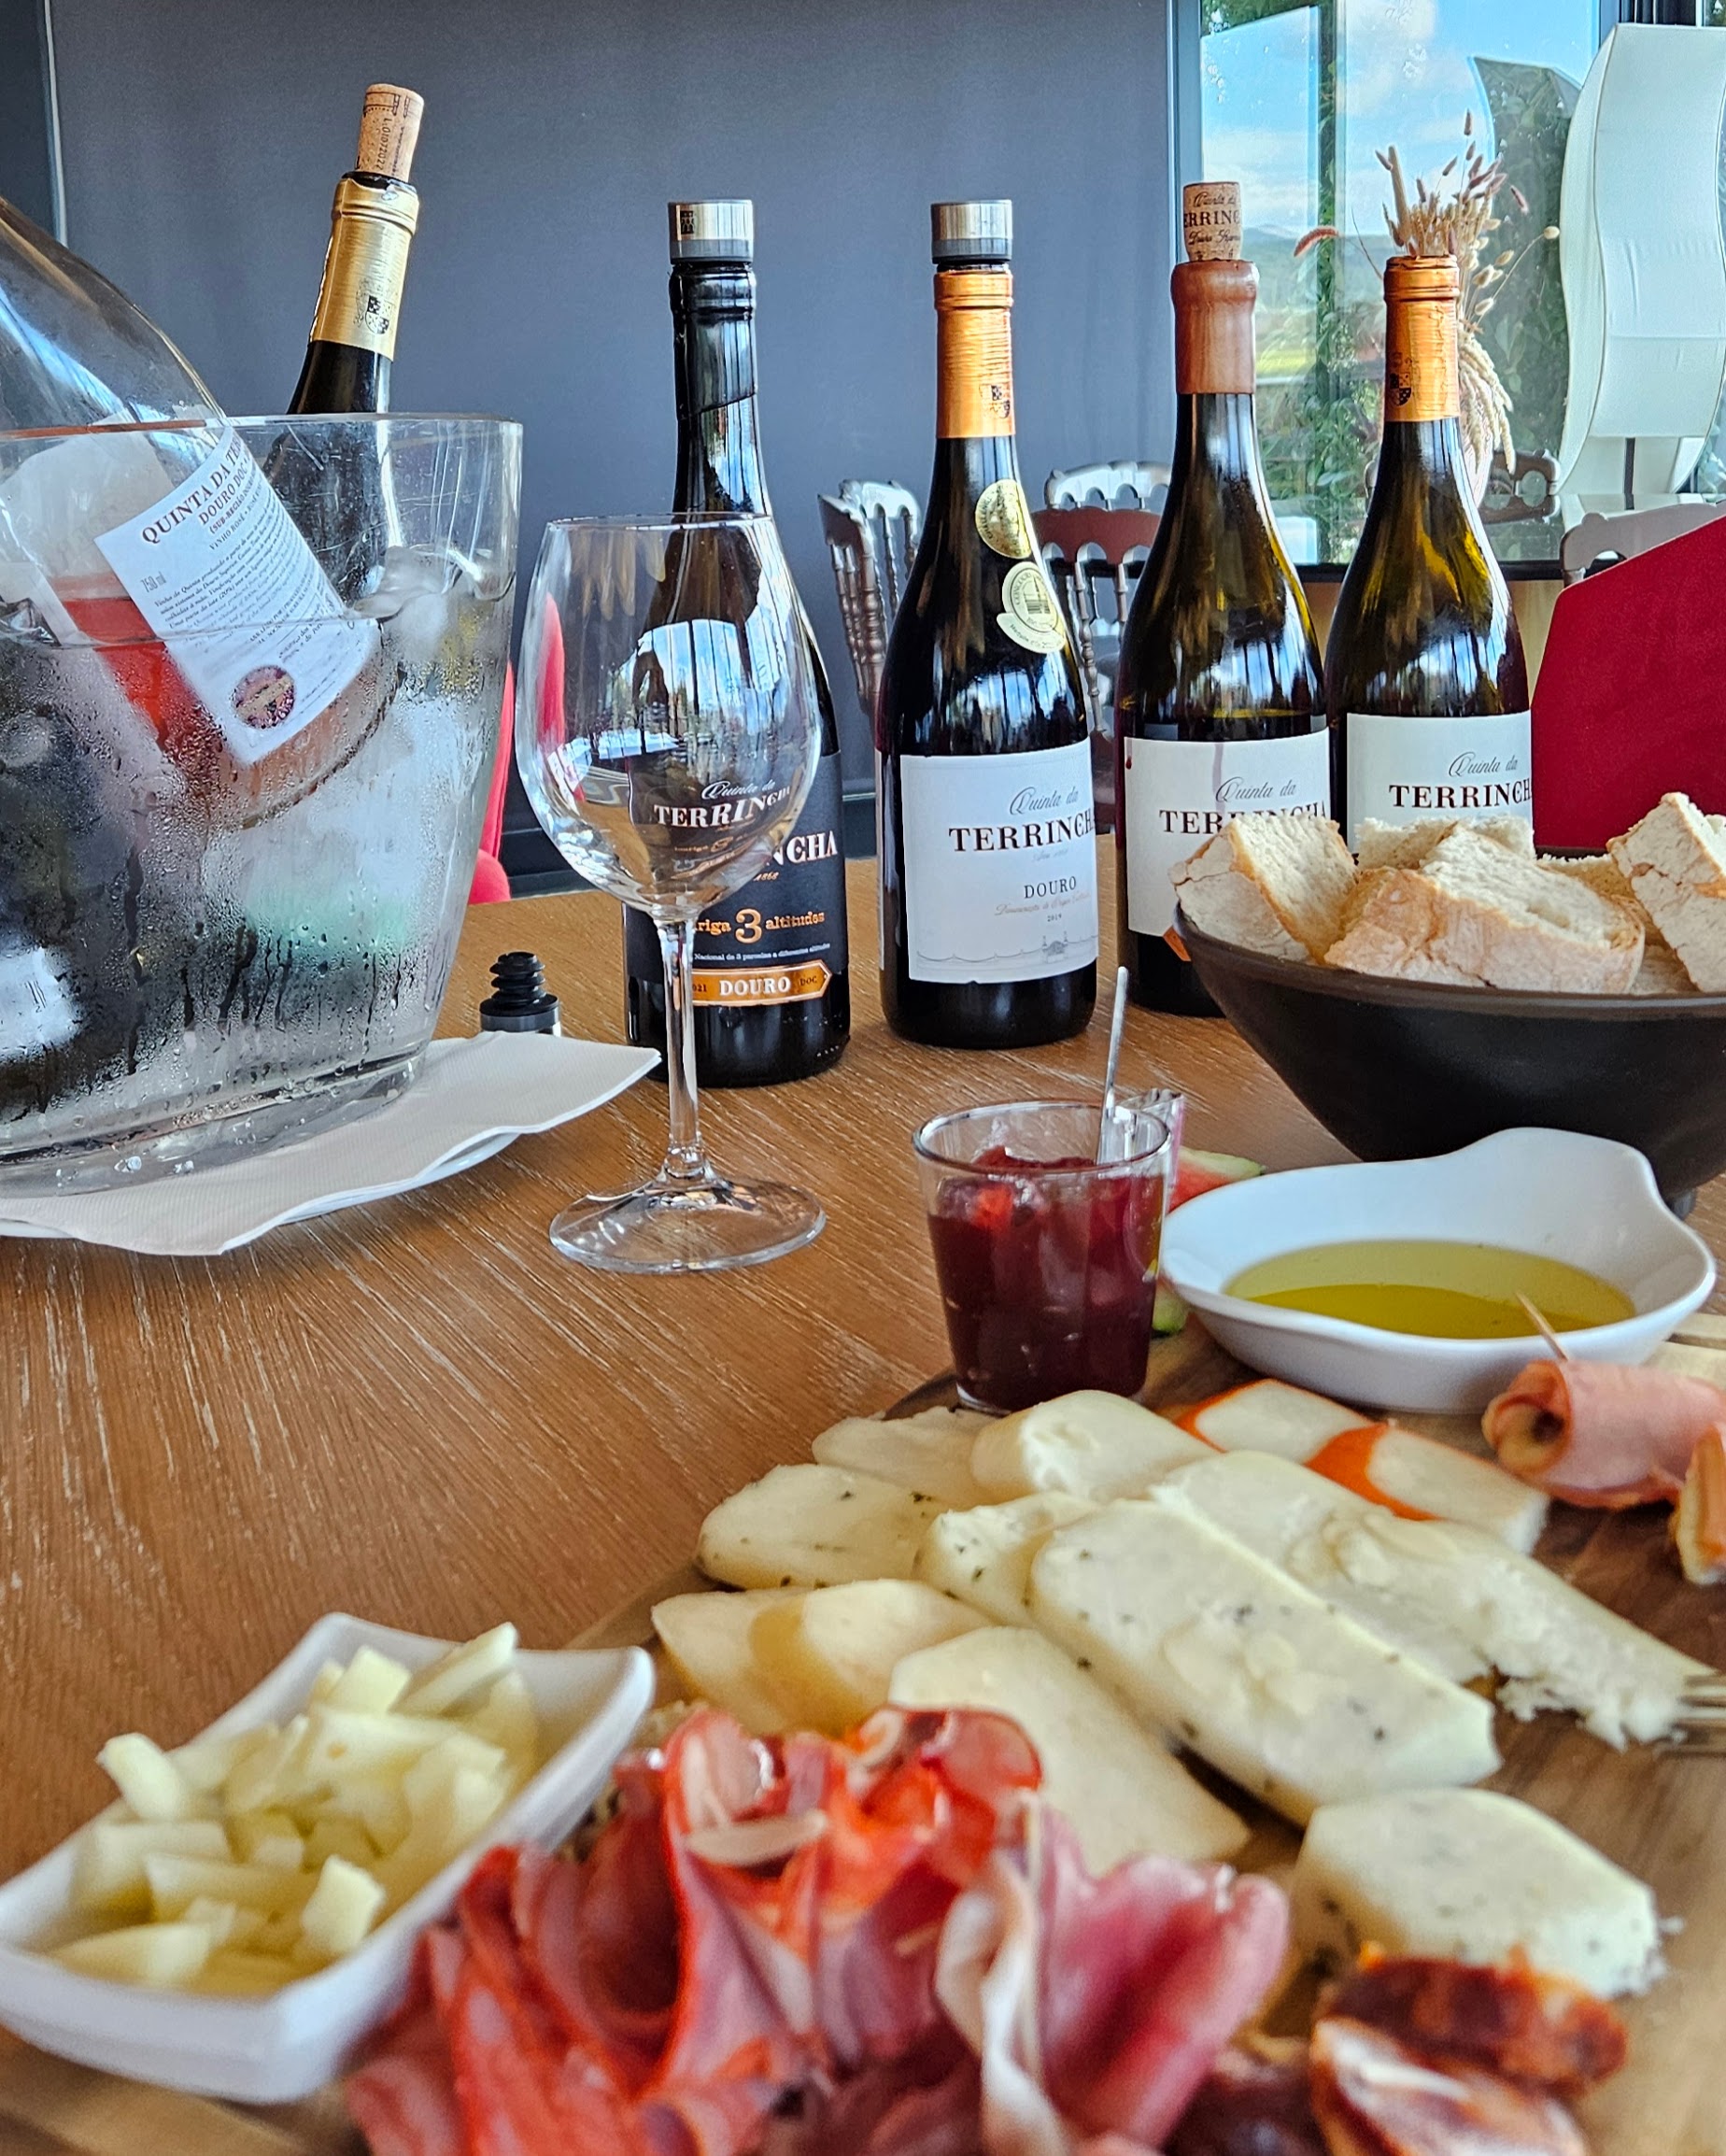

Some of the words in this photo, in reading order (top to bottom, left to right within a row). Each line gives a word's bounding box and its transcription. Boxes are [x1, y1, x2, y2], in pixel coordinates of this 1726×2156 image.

[142, 484, 213, 545] QUINTA
[209, 463, 231, 489] DA
[197, 483, 236, 525] DOURO
[233, 461, 248, 488] DOC
[1449, 751, 1501, 777] Quinta
[1505, 755, 1518, 771] da
[701, 780, 757, 800] Quinta
[1010, 787, 1061, 816] Quinta
[1066, 786, 1079, 804] da
[1215, 776, 1274, 803] Quinta
[1280, 779, 1296, 797] da
[1389, 777, 1533, 809] TERRINCH
[948, 808, 1095, 852] TERRINCH
[1024, 876, 1077, 900] DOURO
[735, 908, 762, 943] 3
[765, 911, 826, 930] altitudes
[692, 984, 707, 992] 021
[719, 976, 791, 997] DOURO
[799, 975, 817, 986] DOC
